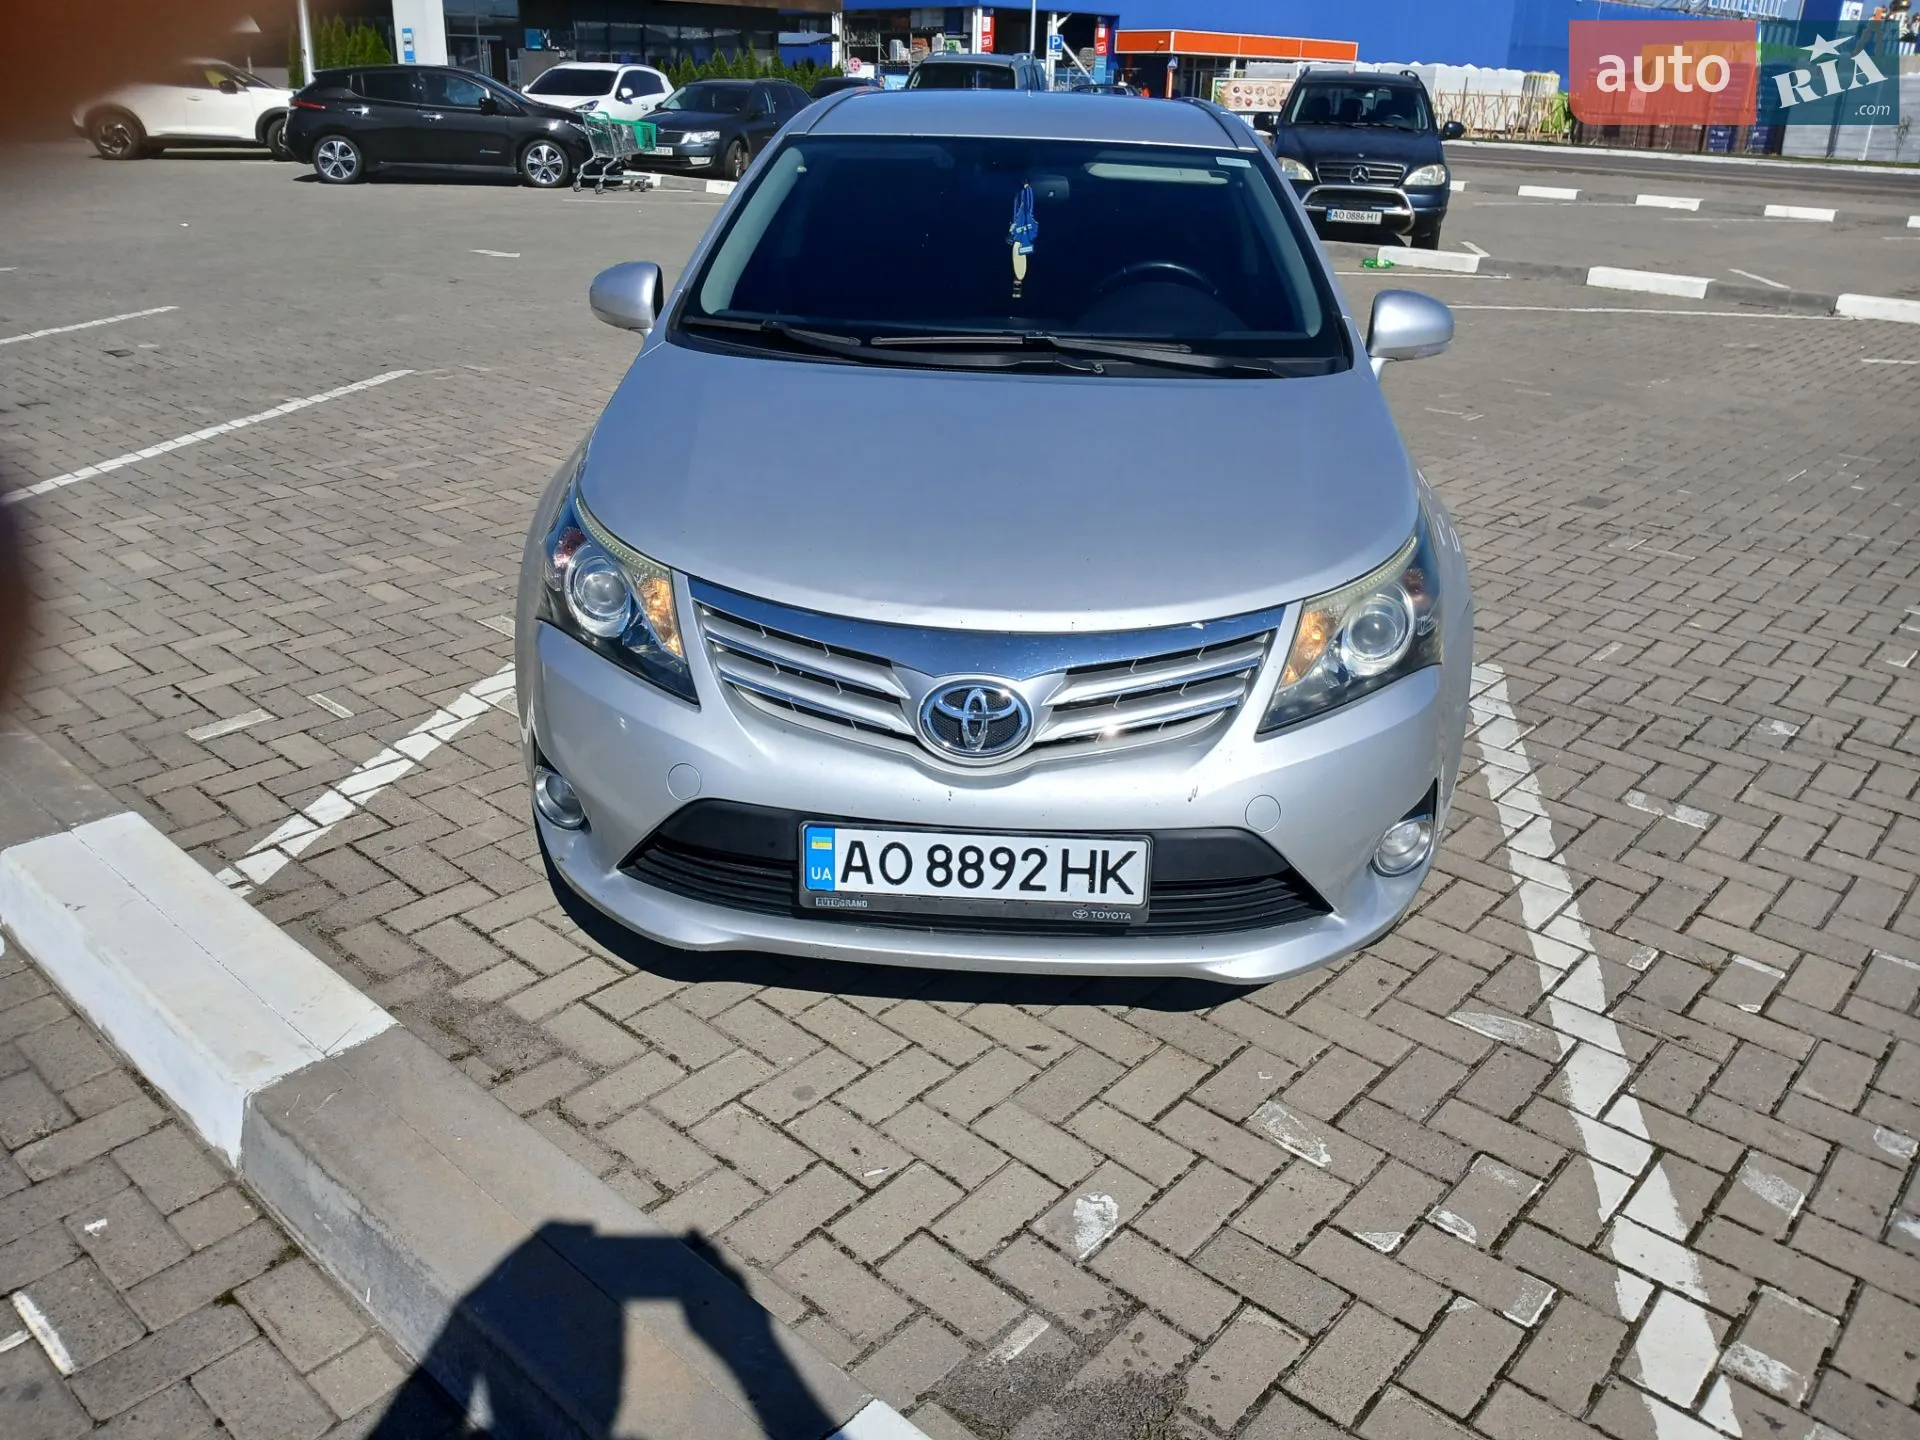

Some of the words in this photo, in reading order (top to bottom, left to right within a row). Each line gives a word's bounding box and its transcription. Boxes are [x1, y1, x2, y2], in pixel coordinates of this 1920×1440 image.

[1052, 36, 1061, 49] P
[811, 866, 833, 881] UA
[840, 840, 913, 886] AO
[926, 844, 1049, 893] 8892
[1060, 848, 1138, 895] HK
[1090, 910, 1132, 920] TOYOTA
